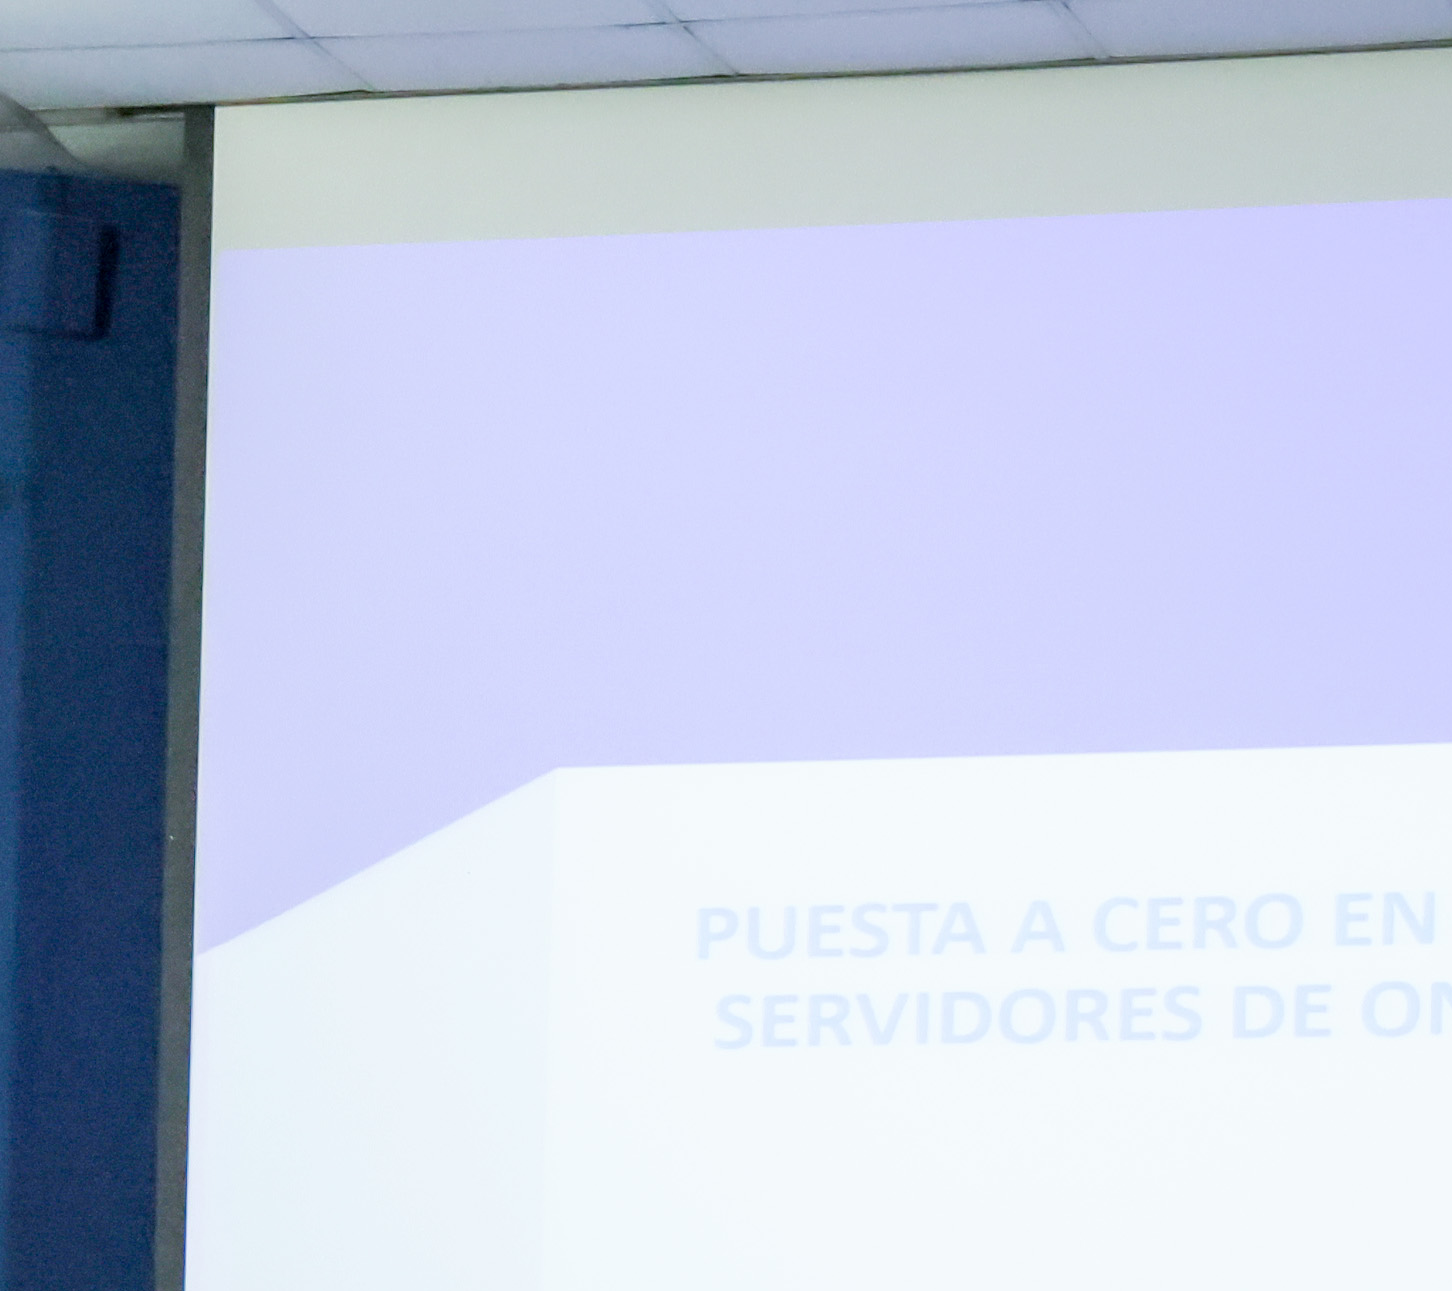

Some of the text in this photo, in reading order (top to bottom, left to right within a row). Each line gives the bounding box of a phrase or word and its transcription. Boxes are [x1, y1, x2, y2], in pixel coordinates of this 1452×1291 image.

[697, 901, 987, 960] PUESTA
[1010, 899, 1066, 954] A
[1094, 892, 1305, 952] CERO
[1333, 891, 1437, 947] EN
[714, 984, 1203, 1050] SERVIDORES
[1232, 983, 1333, 1039] DE
